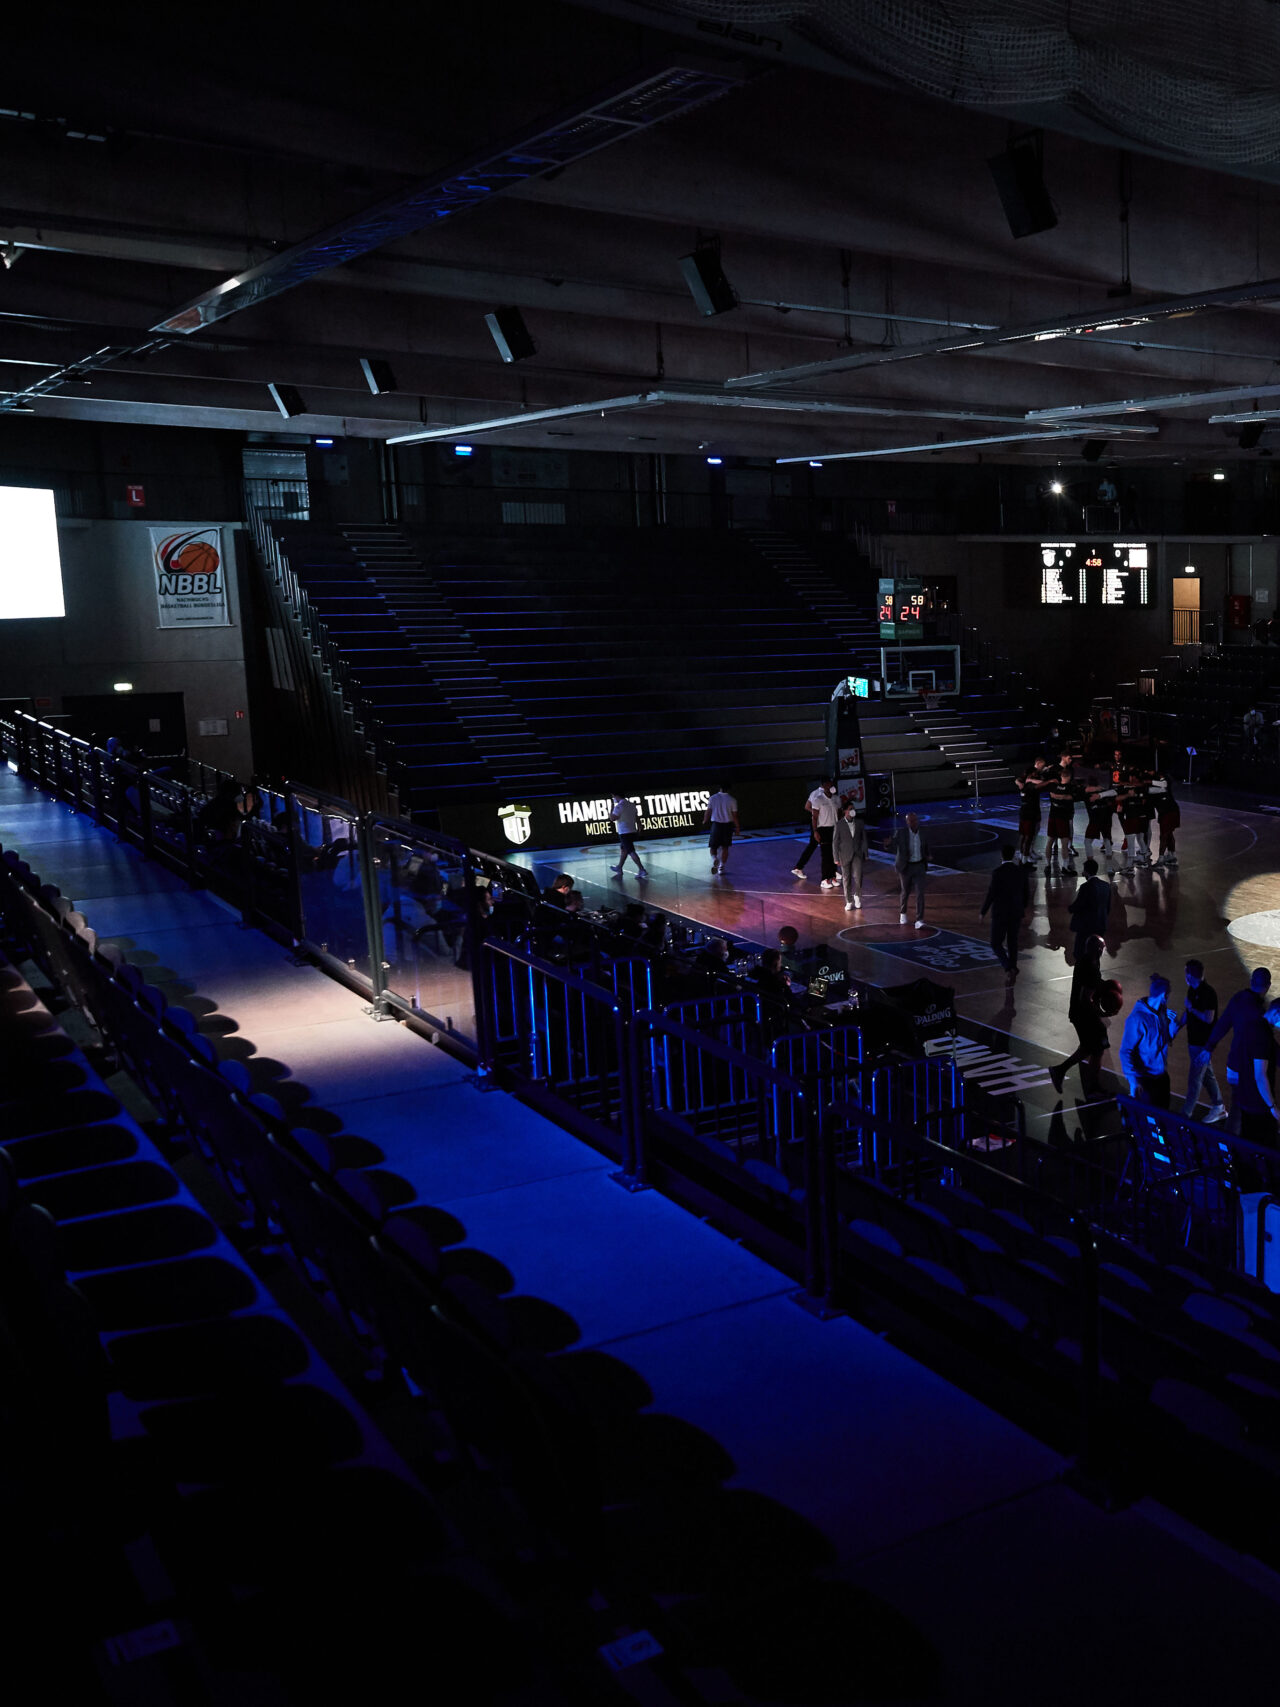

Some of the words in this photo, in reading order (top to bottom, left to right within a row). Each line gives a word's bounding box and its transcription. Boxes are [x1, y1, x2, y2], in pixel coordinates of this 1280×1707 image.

[698, 20, 782, 51] elan
[131, 489, 141, 502] L
[1085, 558, 1103, 567] 4:58
[159, 572, 222, 595] NBBL
[884, 595, 894, 606] 58
[911, 595, 924, 606] 58
[880, 606, 891, 620] 24
[900, 606, 920, 621] 24
[558, 796, 643, 824] HAMBG
[644, 790, 711, 816] TOWERS
[585, 821, 613, 836] MORE
[640, 814, 695, 831] BASKETBALL
[914, 1006, 951, 1028] SPALDING
